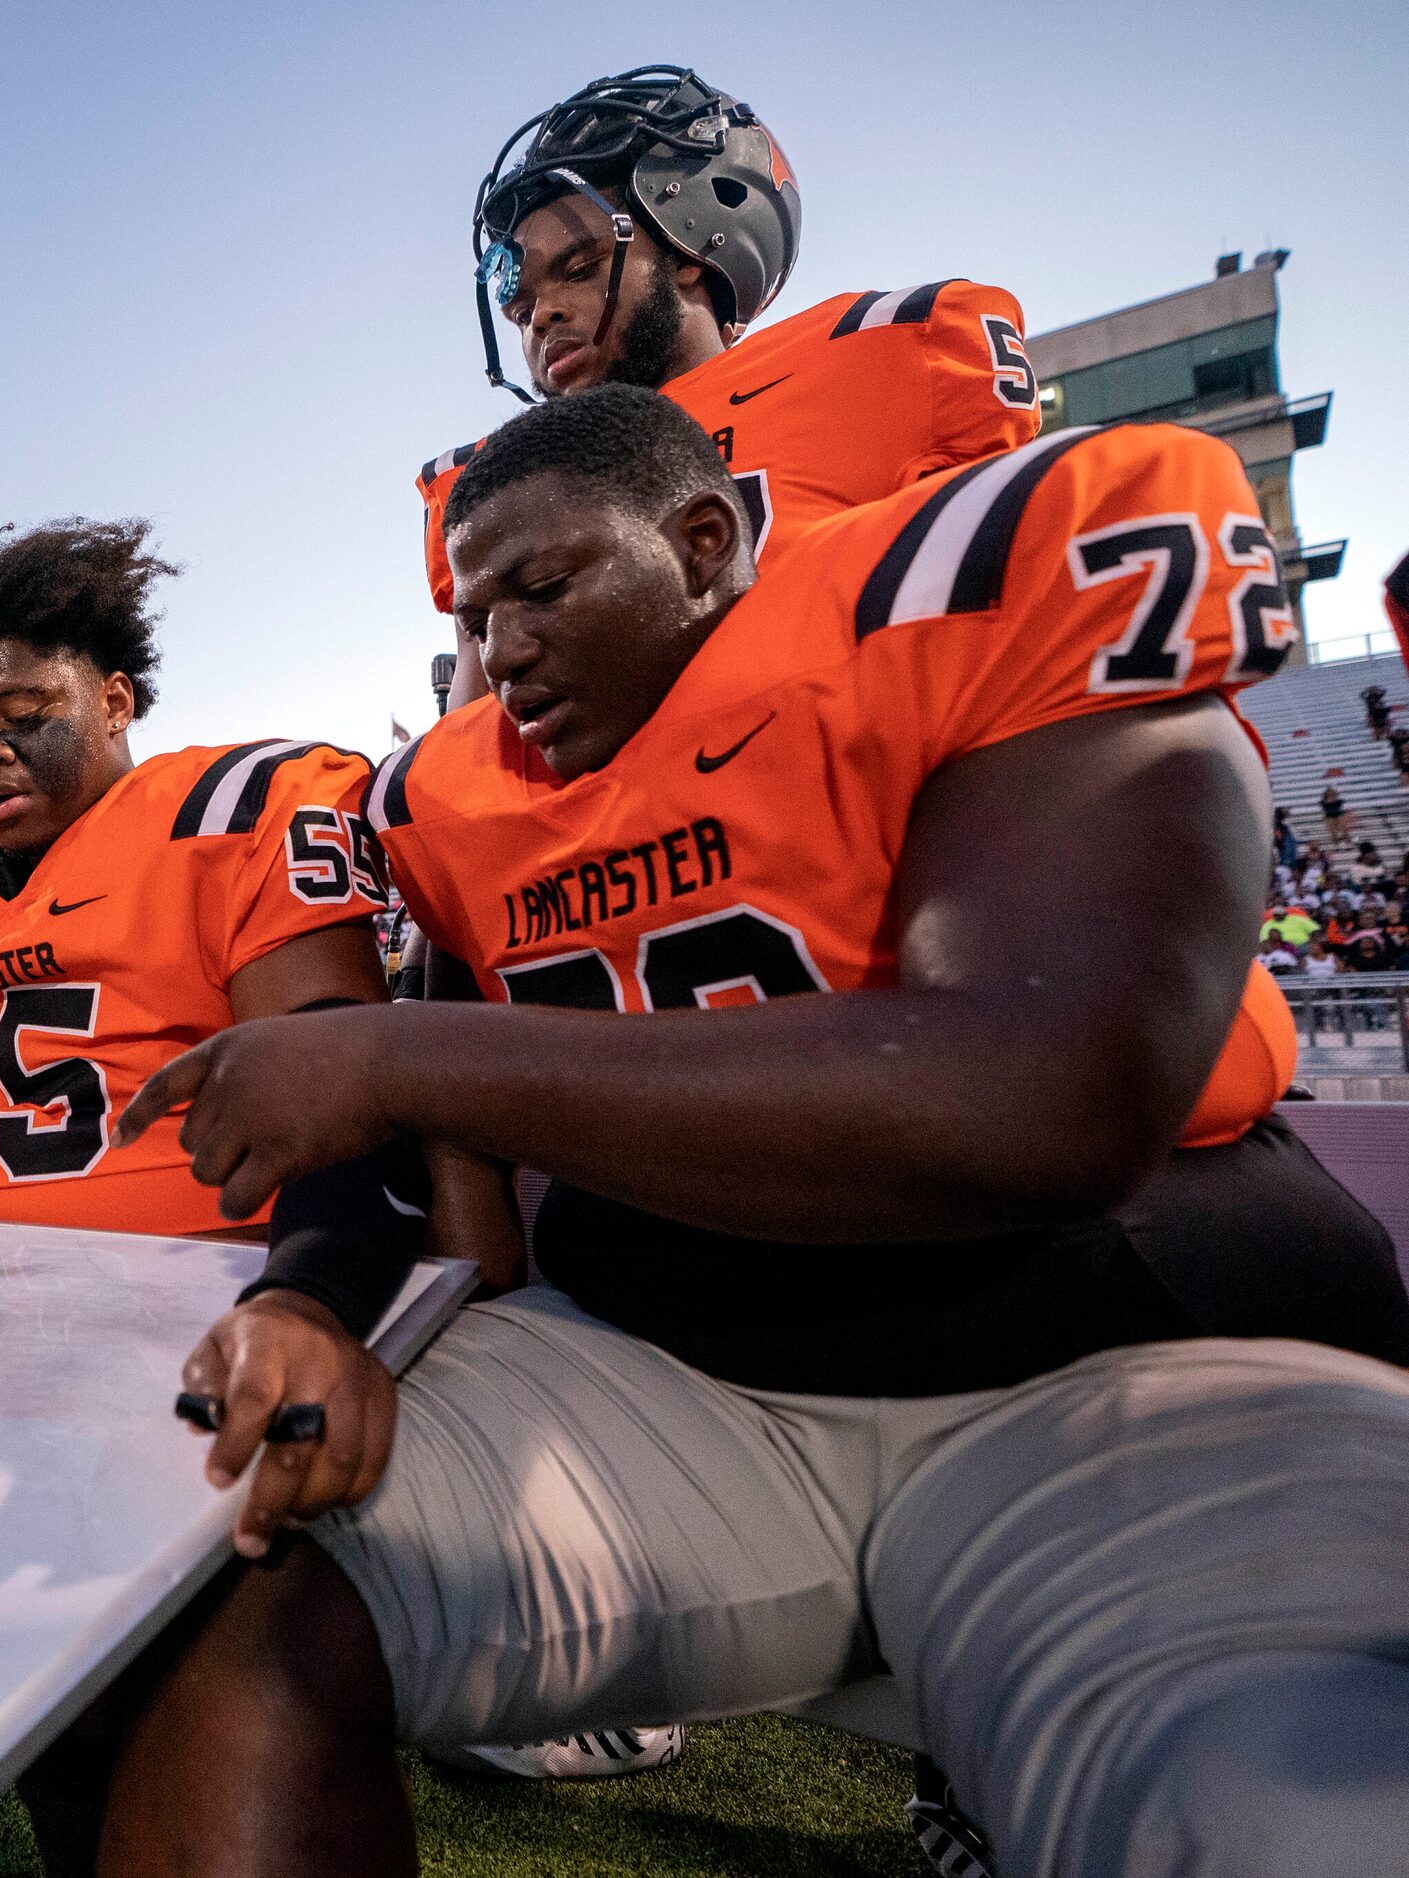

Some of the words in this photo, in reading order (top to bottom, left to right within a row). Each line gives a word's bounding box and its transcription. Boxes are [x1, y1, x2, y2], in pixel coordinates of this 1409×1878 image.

[1067, 512, 1299, 694] 72
[284, 804, 391, 909] 55
[503, 814, 733, 950] LANCASTER
